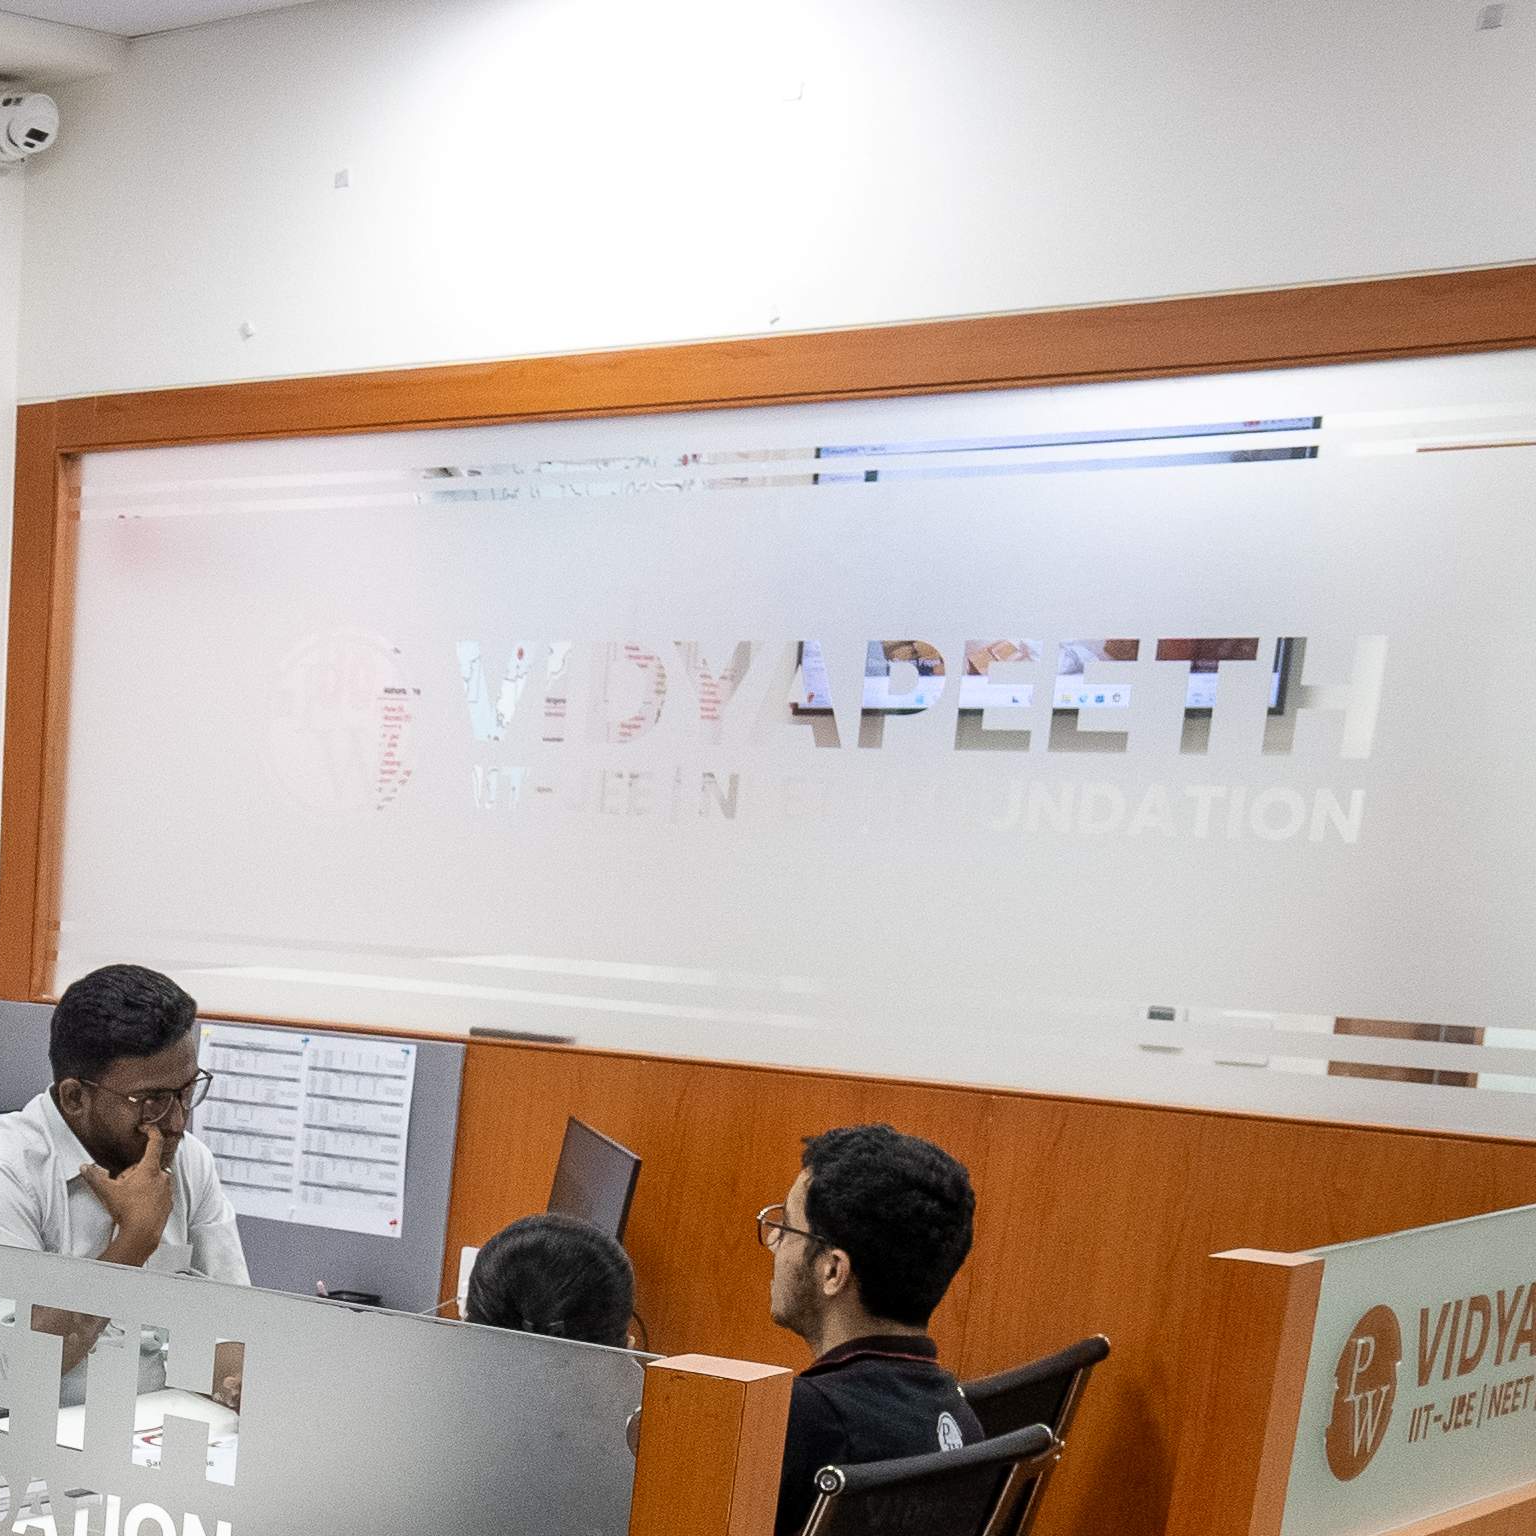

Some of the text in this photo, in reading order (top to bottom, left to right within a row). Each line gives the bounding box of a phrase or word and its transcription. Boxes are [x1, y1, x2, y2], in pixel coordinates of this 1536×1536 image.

[455, 634, 1389, 759] VIDYAPEETH
[1408, 1379, 1529, 1443] IIT-JEE NEET
